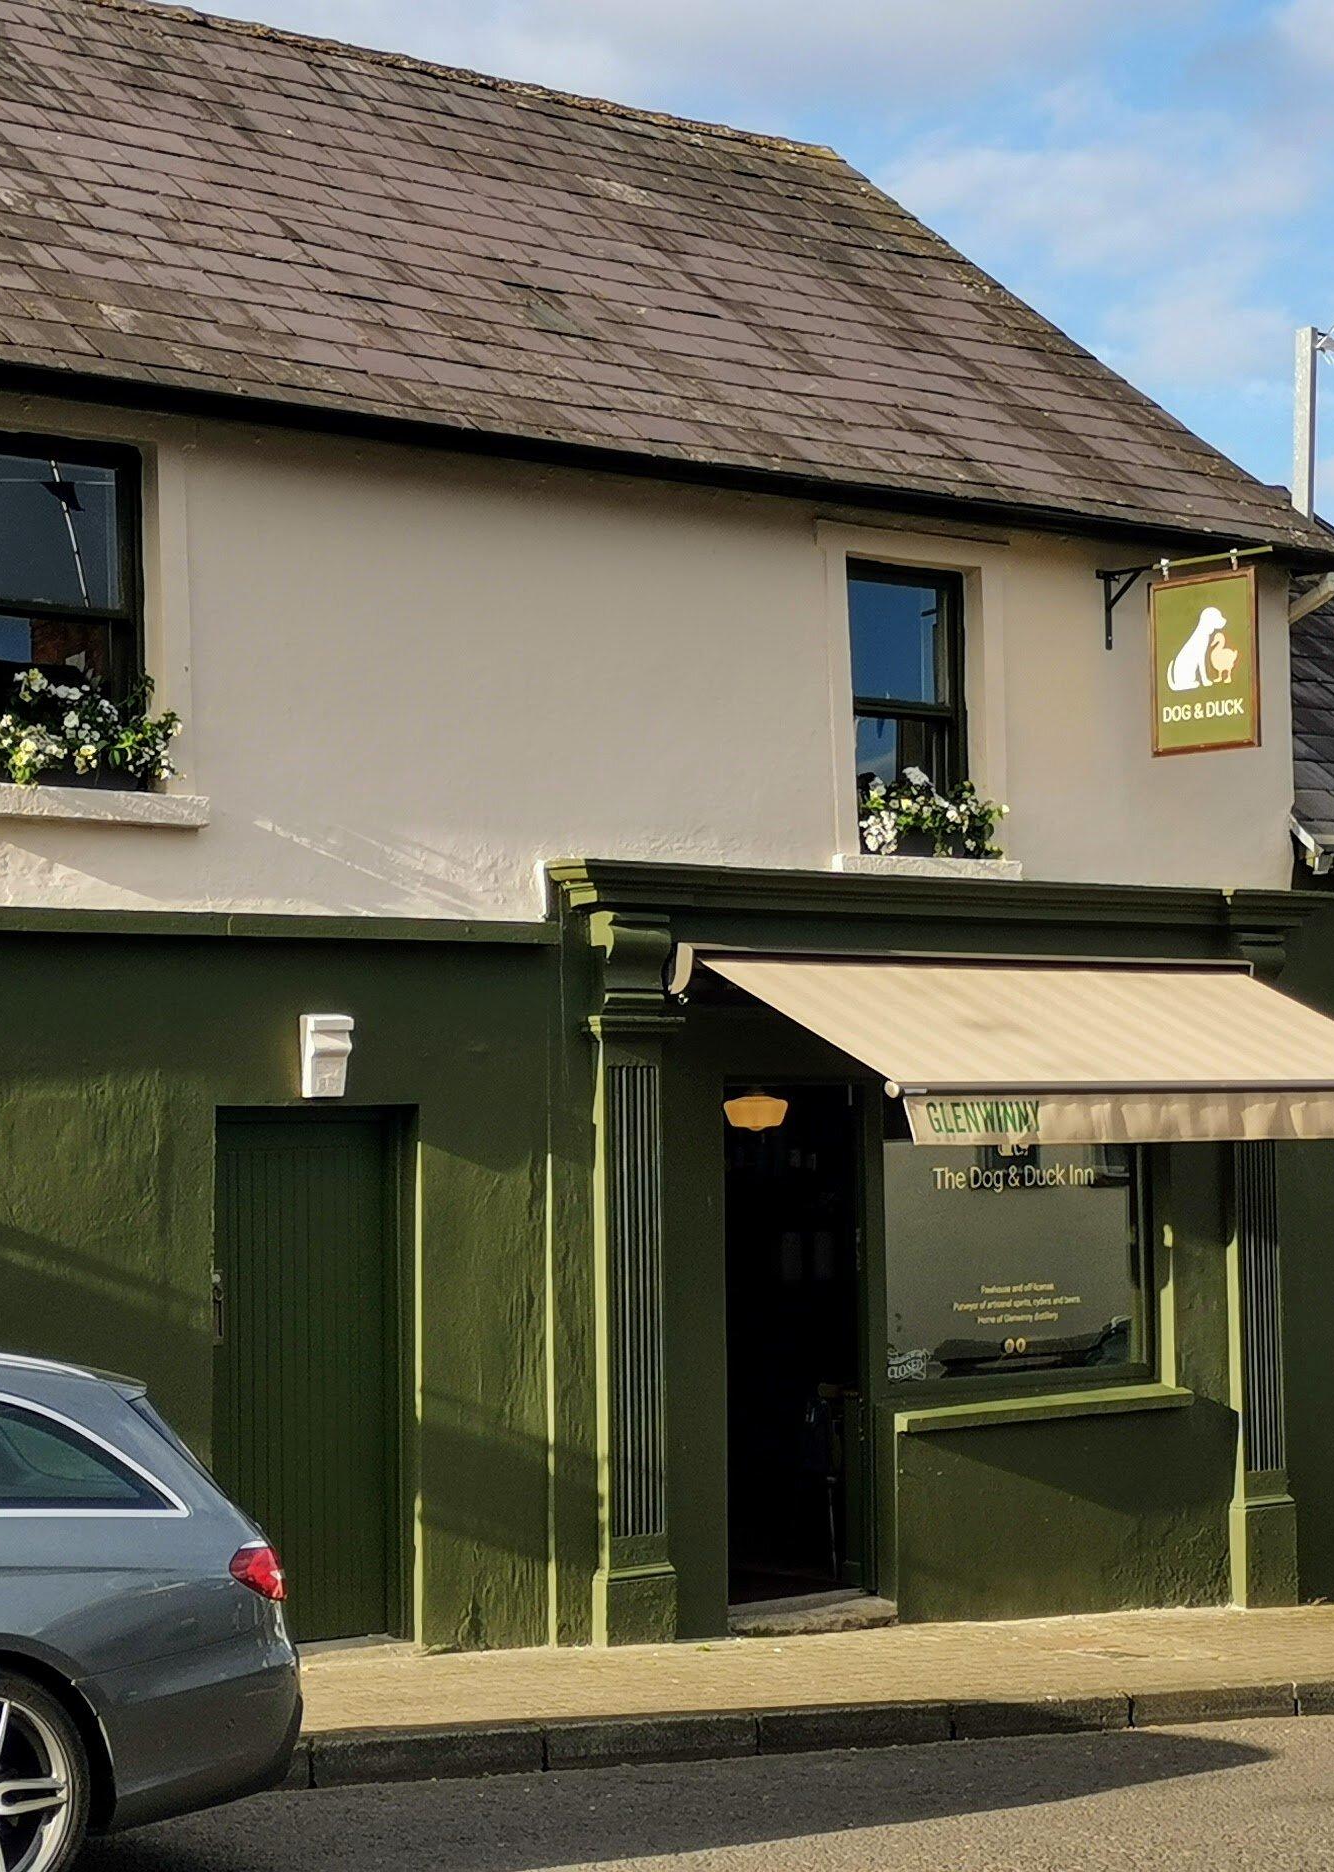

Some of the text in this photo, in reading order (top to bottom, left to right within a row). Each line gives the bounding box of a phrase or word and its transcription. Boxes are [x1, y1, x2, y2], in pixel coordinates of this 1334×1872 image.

[1163, 698, 1244, 723] DOG & DUCK
[926, 1100, 1040, 1133] GLENWINNY
[932, 1163, 1094, 1193] The Dog & Duck Inn
